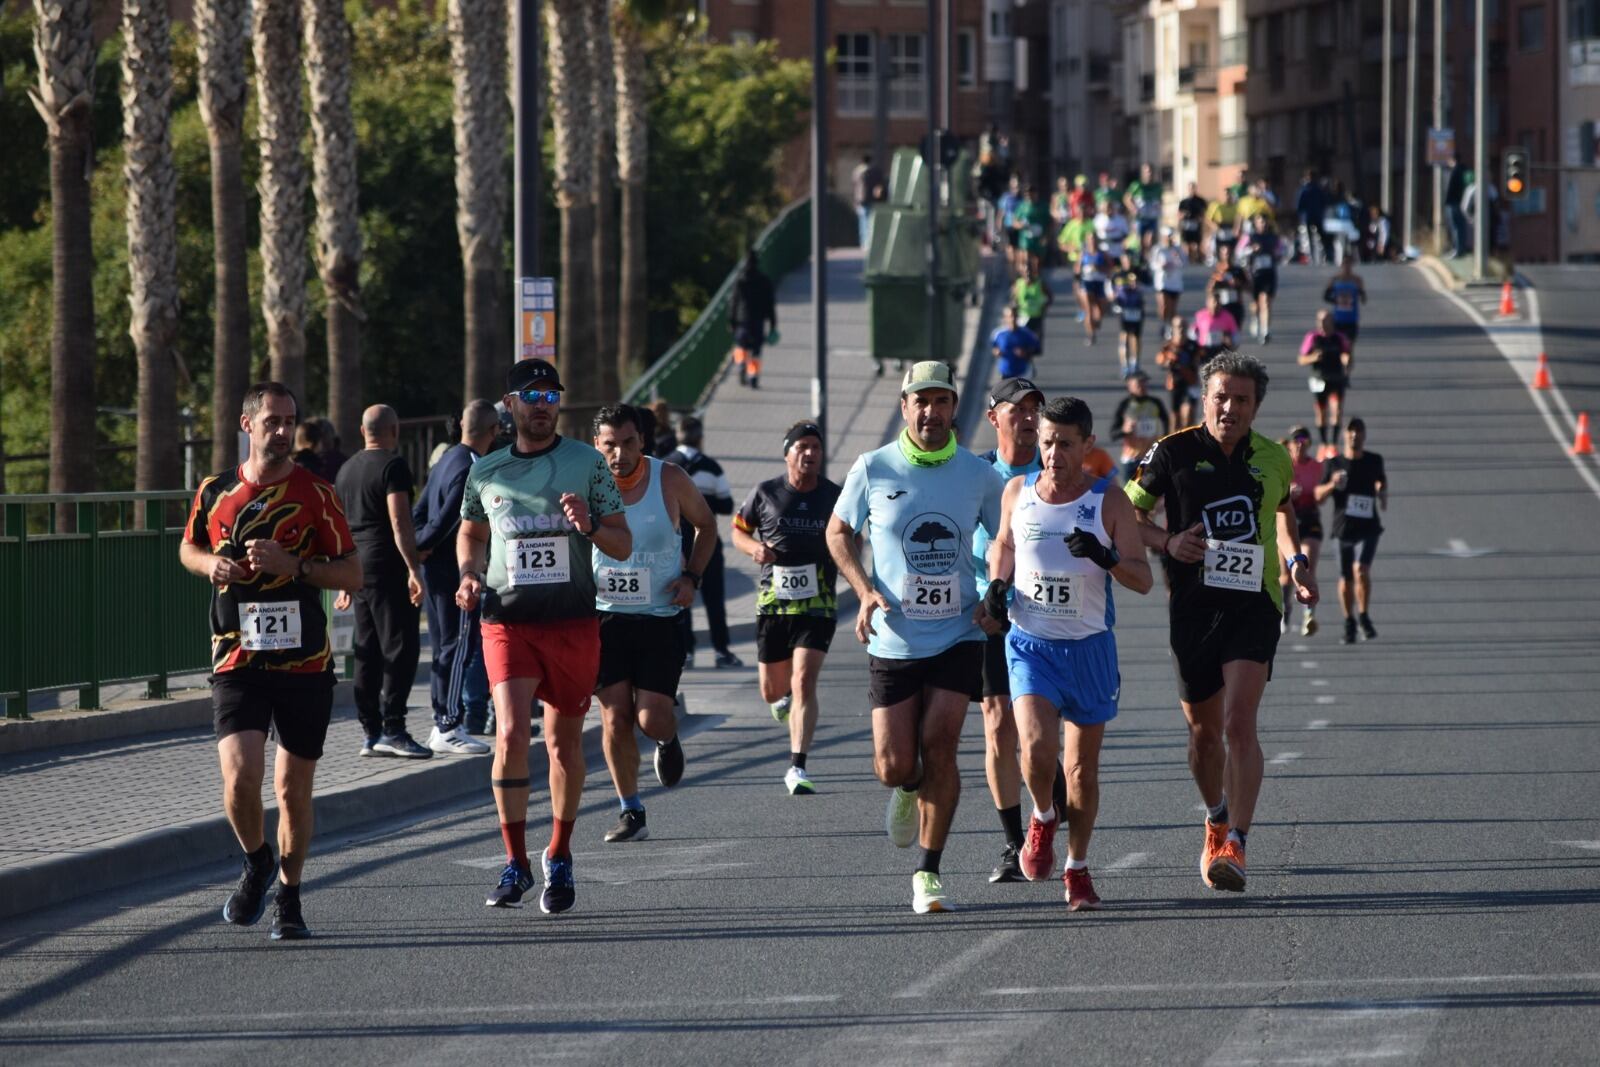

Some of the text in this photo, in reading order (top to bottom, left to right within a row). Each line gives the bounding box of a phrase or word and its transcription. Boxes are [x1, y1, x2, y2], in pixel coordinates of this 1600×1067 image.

[1216, 511, 1245, 527] KD
[1226, 546, 1254, 555] ANDAMUR
[518, 550, 556, 569] 123
[1215, 554, 1253, 575] 222
[608, 578, 640, 593] 328
[782, 574, 808, 589] 200
[1208, 575, 1241, 585] AVANZA
[916, 587, 951, 605] 261
[1034, 584, 1070, 603] 215
[906, 607, 940, 615] AVANZA
[1028, 604, 1057, 614] AVANZA
[254, 615, 288, 634] 121
